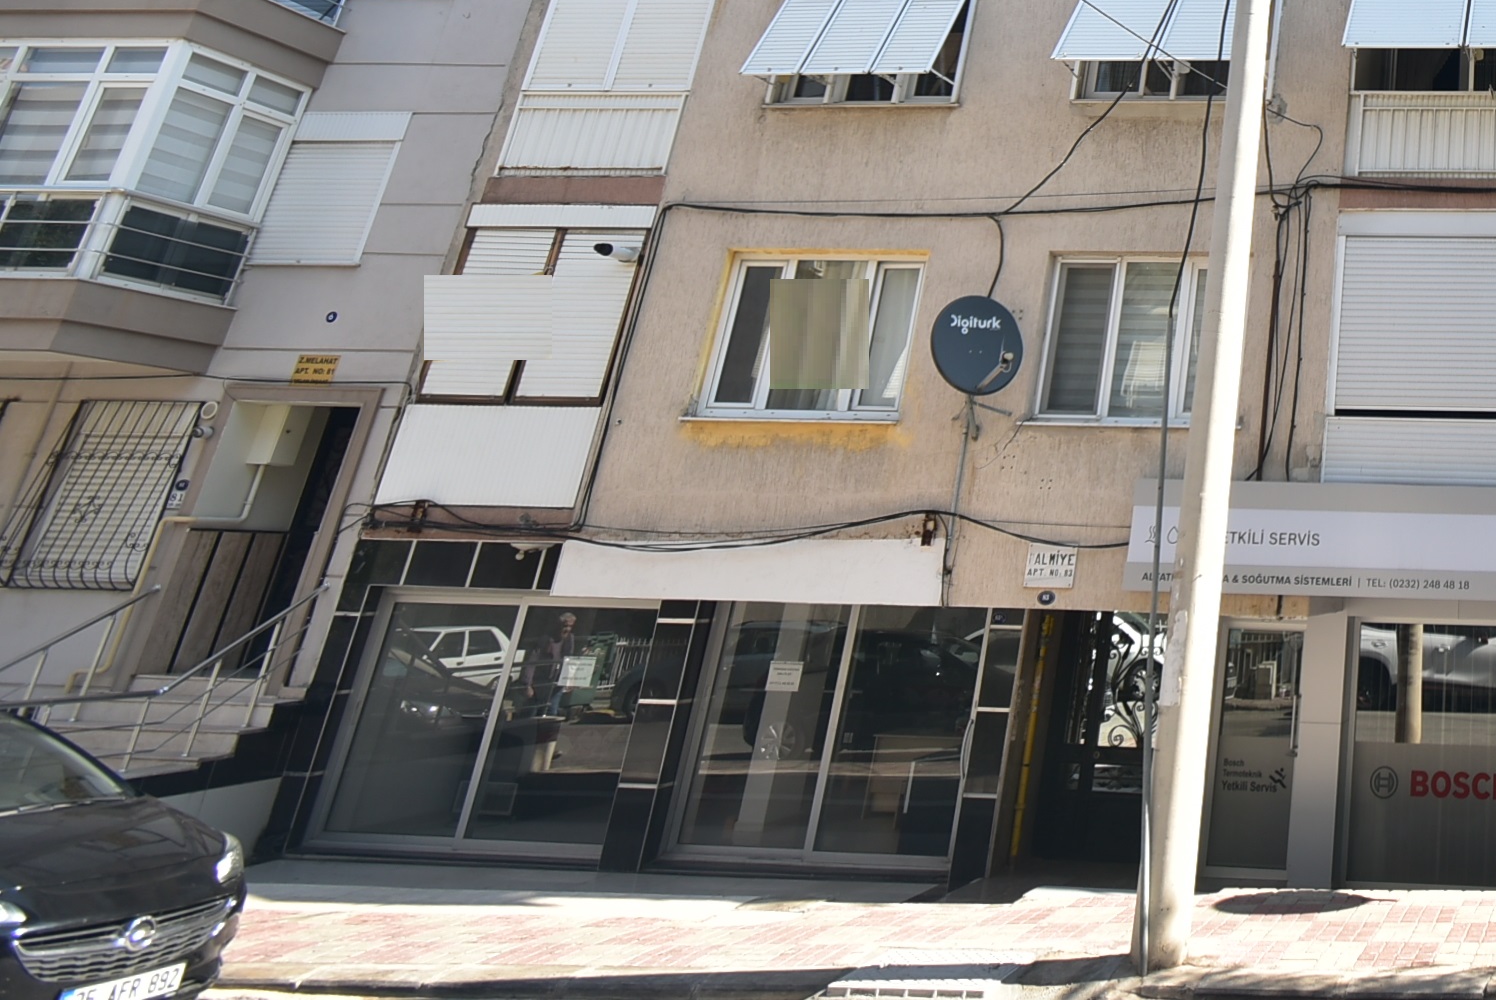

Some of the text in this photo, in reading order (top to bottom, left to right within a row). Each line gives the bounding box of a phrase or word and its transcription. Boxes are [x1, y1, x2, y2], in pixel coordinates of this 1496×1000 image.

[950, 314, 1001, 335] Digiturk
[1268, 529, 1320, 547] SERVİS
[1241, 573, 1291, 585] SOĞUTMA
[1294, 575, 1352, 587] SİSTEMLERİ
[1366, 578, 1386, 588] TEL:
[1389, 578, 1420, 590] (0232)
[1423, 579, 1441, 590] 248
[1443, 579, 1457, 590] 48
[1458, 579, 1470, 590] 18
[1223, 758, 1244, 767] Bosch
[1222, 768, 1262, 778] Termoteknik
[1221, 780, 1277, 792] Yetkili Servis
[148, 967, 180, 993] 892
